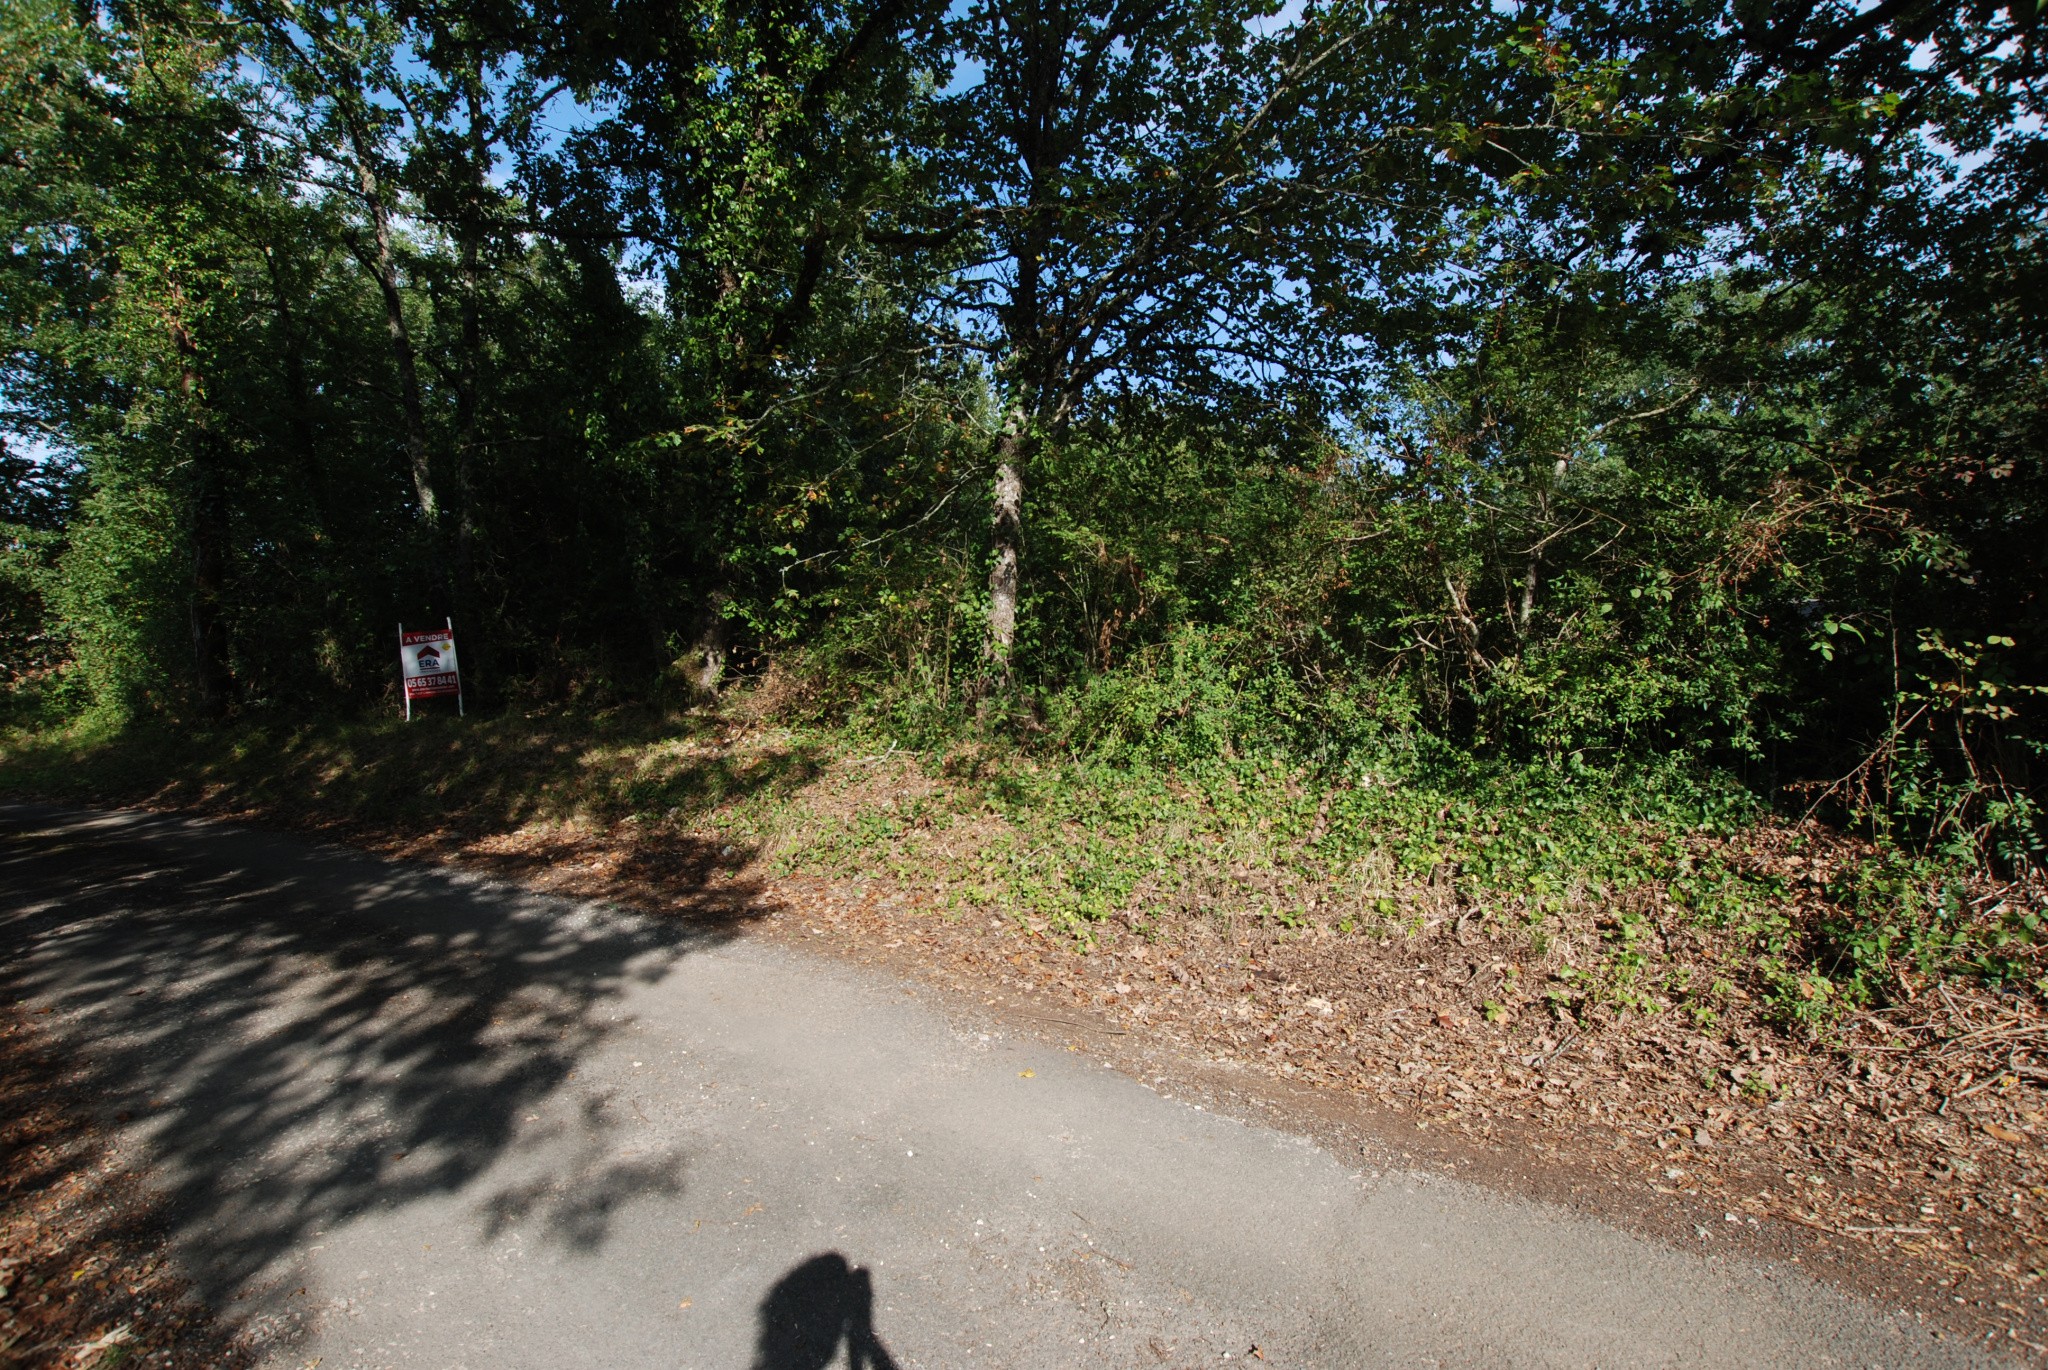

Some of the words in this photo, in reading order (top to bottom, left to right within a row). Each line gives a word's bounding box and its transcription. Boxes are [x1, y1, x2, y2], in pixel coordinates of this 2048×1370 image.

[414, 633, 449, 643] VENDRE
[419, 659, 440, 668] ERA
[407, 678, 417, 688] 05
[417, 677, 427, 687] 65
[428, 677, 436, 686] 37
[447, 674, 457, 684] 41
